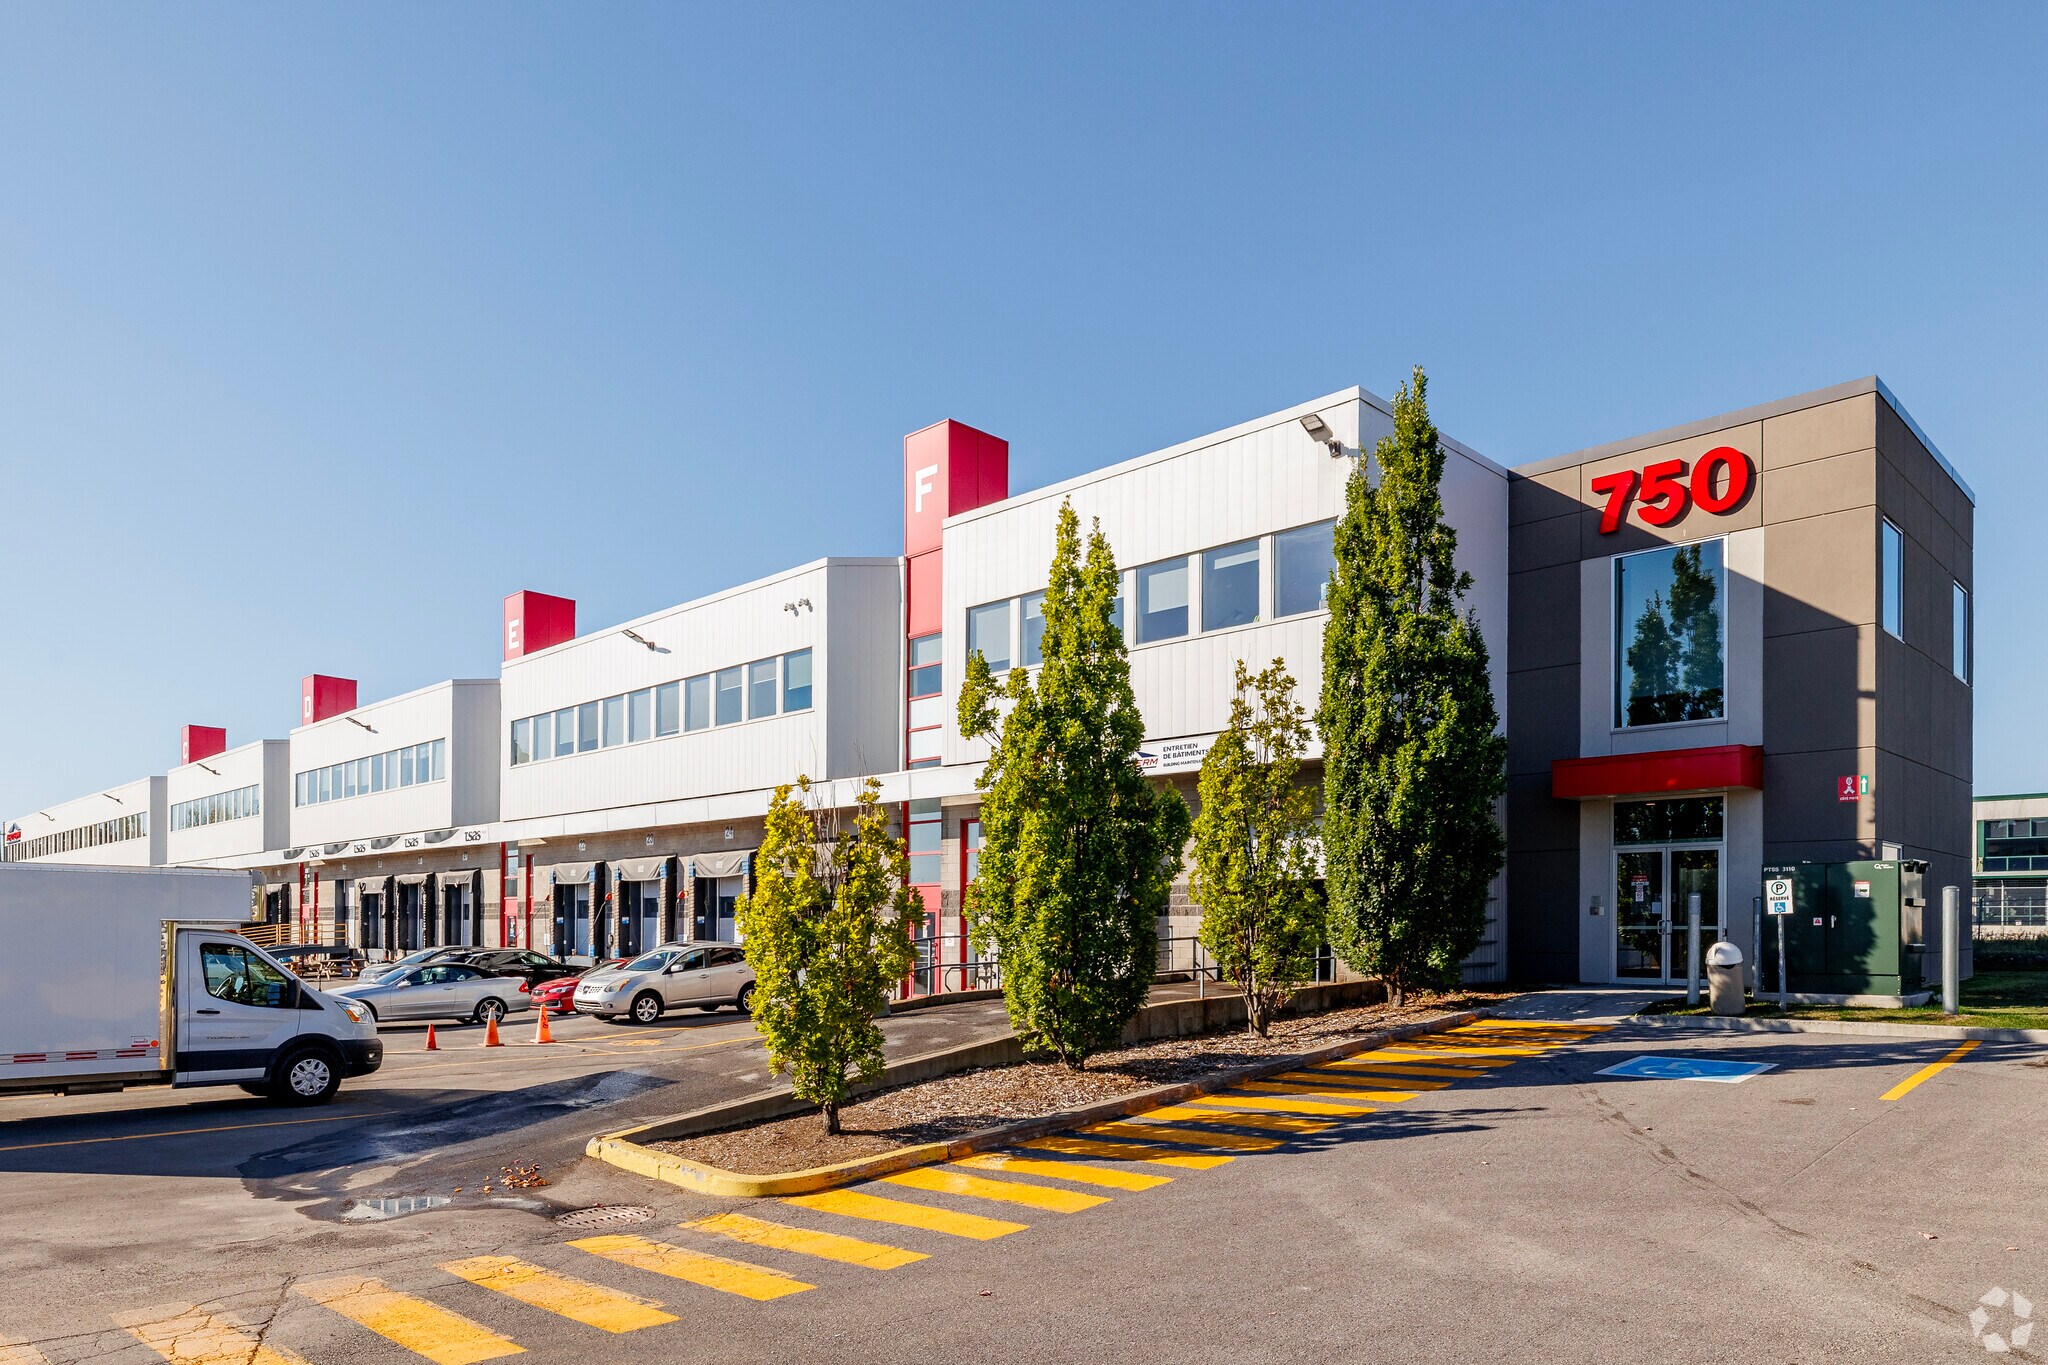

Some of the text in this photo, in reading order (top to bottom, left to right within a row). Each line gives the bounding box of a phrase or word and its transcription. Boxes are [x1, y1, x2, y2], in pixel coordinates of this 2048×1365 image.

[915, 463, 939, 513] F
[1591, 446, 1750, 535] 750
[508, 619, 520, 650] E
[305, 696, 312, 719] D
[1162, 743, 1198, 752] ENTRETIEN
